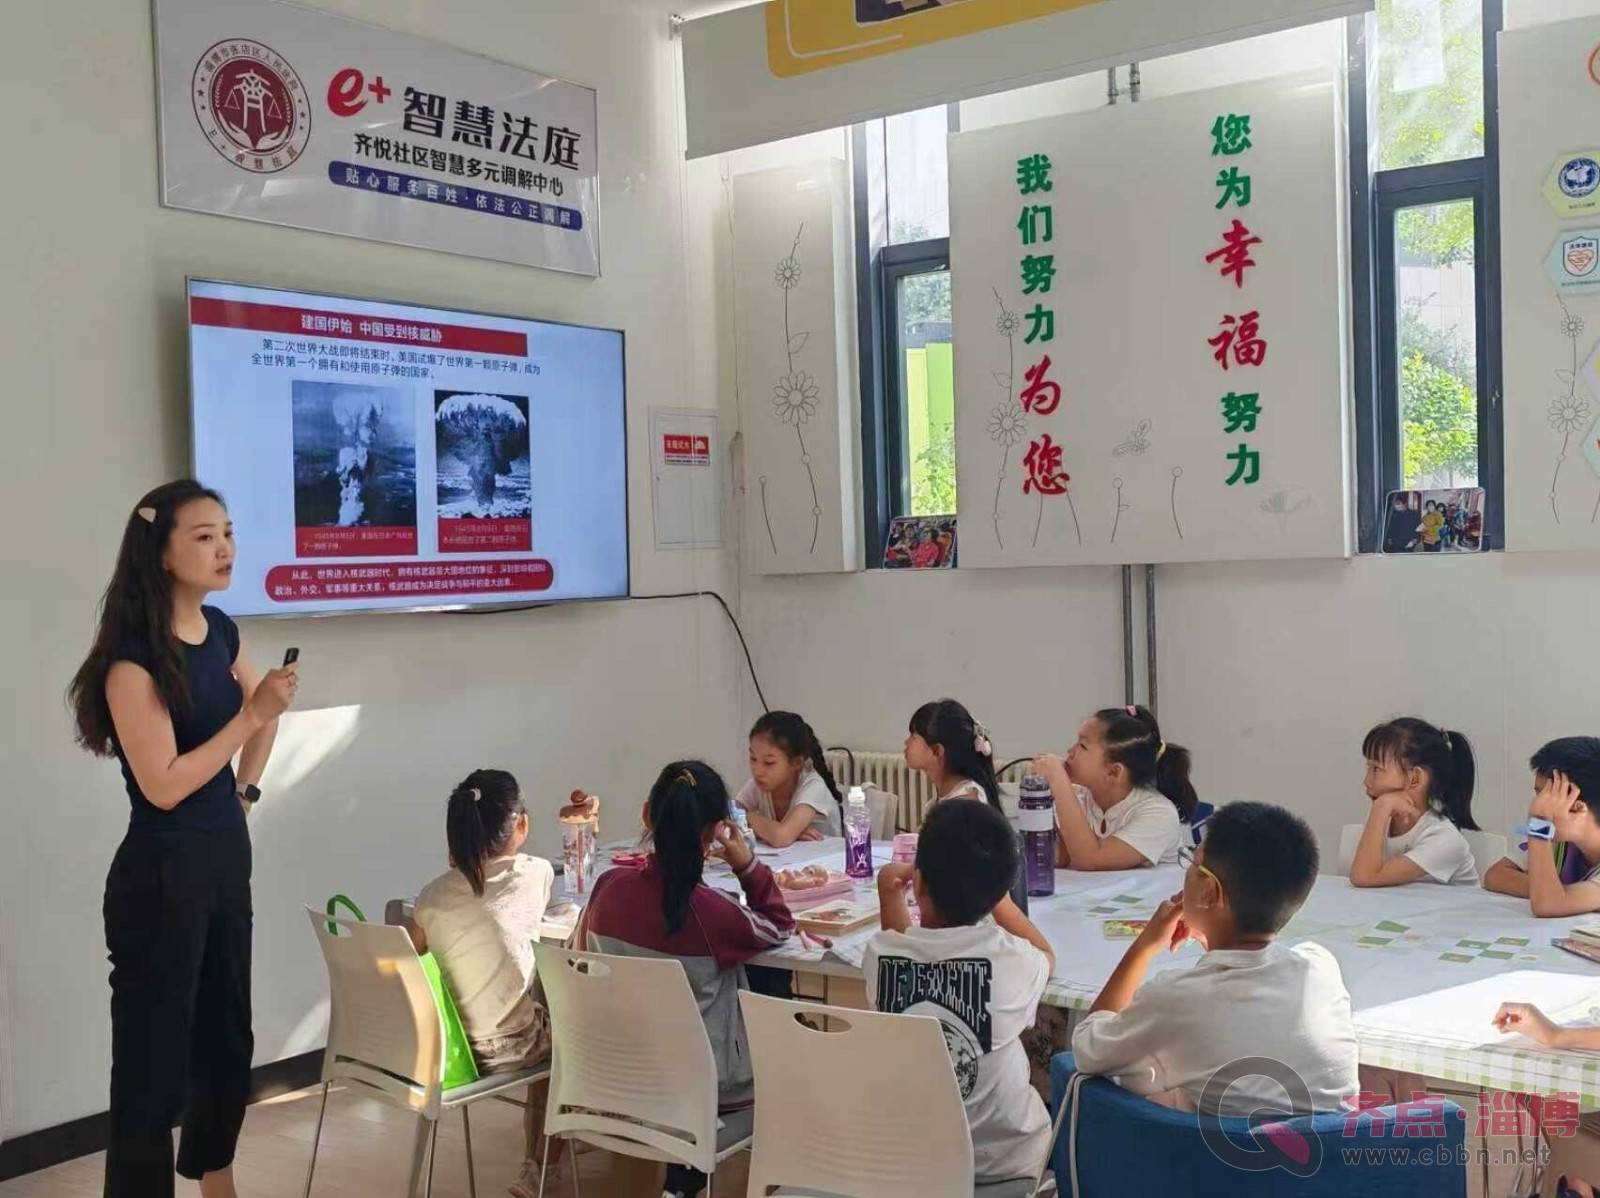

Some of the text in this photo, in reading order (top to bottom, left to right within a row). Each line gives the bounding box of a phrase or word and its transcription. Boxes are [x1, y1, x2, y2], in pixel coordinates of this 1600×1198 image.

[354, 133, 564, 197] 齐悦社区智慧多元调解中心
[403, 86, 582, 171] 智慧法庭
[301, 314, 443, 343] 建国伊始 中国受到核威胁
[1016, 153, 1071, 496] 我们努力为您
[1205, 113, 1268, 487] 您为幸福努力
